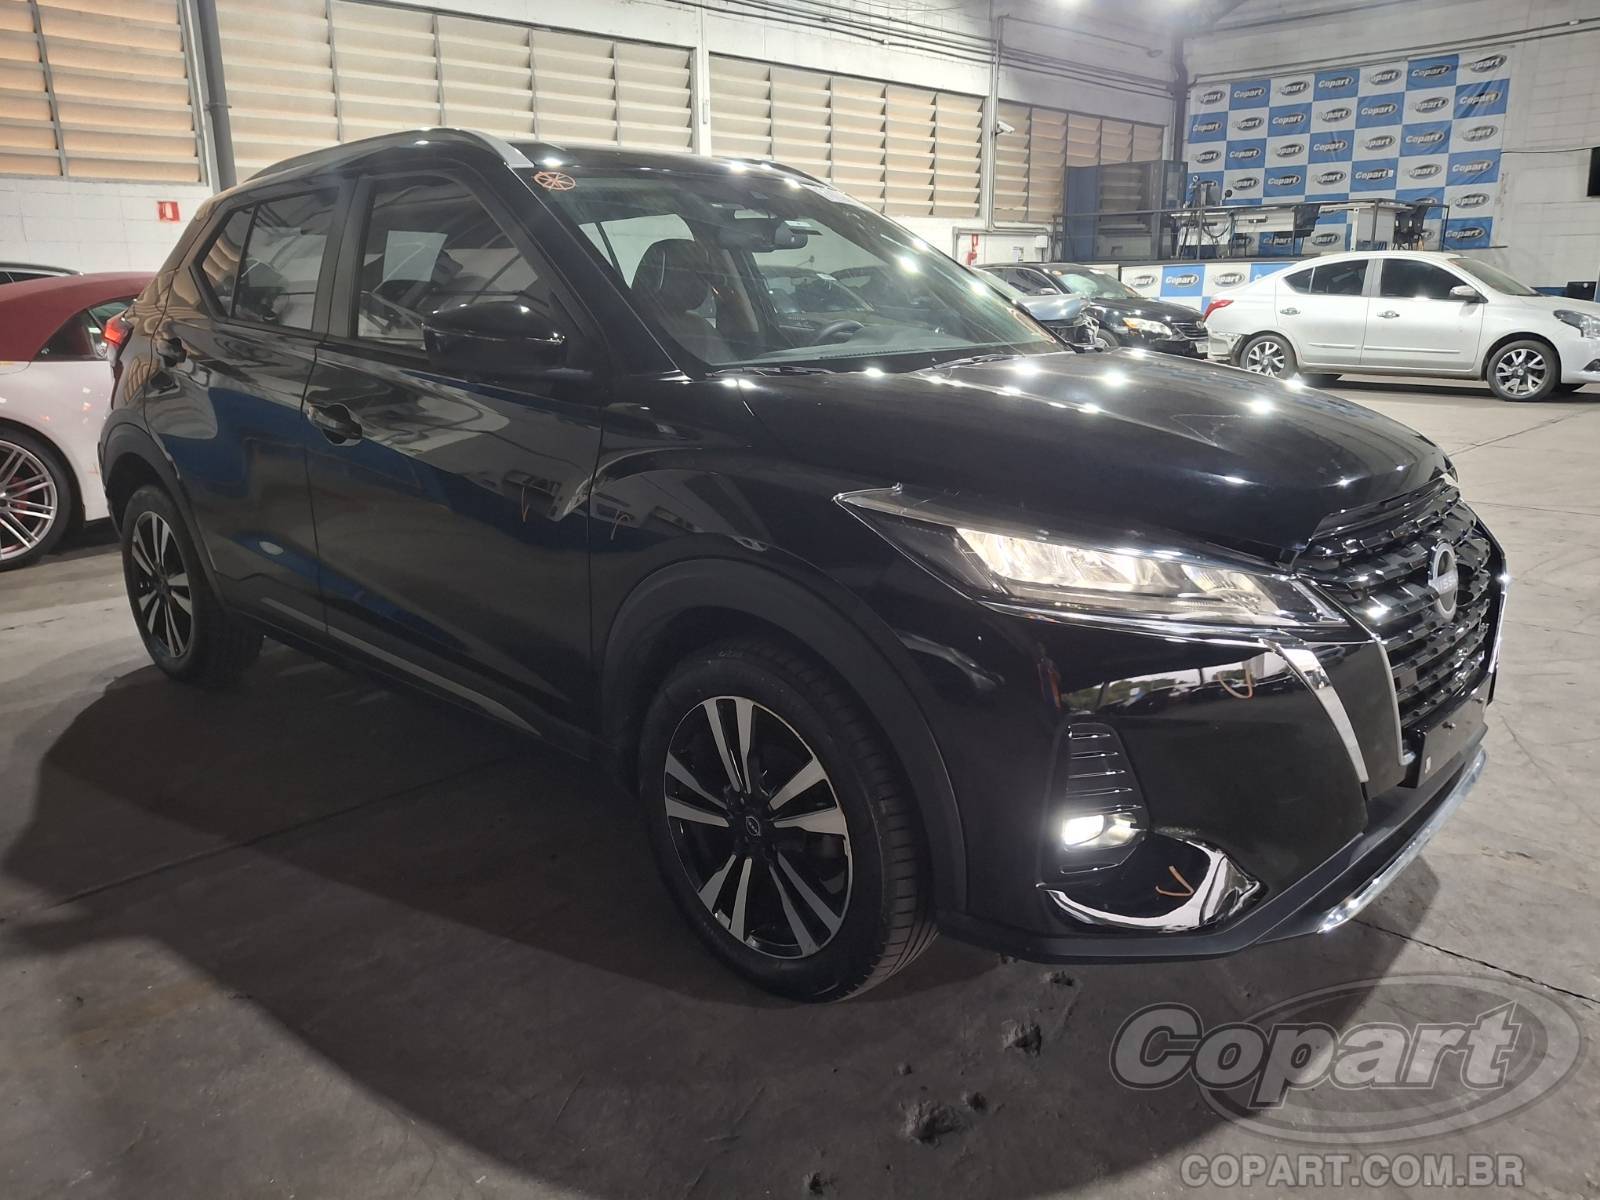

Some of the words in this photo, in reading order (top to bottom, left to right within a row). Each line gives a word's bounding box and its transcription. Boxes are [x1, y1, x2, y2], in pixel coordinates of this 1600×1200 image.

[1411, 66, 1446, 77] Copart
[1318, 77, 1349, 88] Copart
[1233, 88, 1262, 98] Copart
[1459, 93, 1496, 106] Copart
[1361, 104, 1392, 116] Copart
[1272, 115, 1302, 125] Copart
[1193, 122, 1219, 132] Copart
[1406, 133, 1440, 144] Copart
[1313, 141, 1344, 152] Copart
[1229, 149, 1257, 158] Copart
[1452, 162, 1487, 173] Copart
[1268, 176, 1297, 186] Copart
[1355, 170, 1386, 181] Copart
[1445, 228, 1480, 239] Copart
[1165, 275, 1195, 286] Copart
